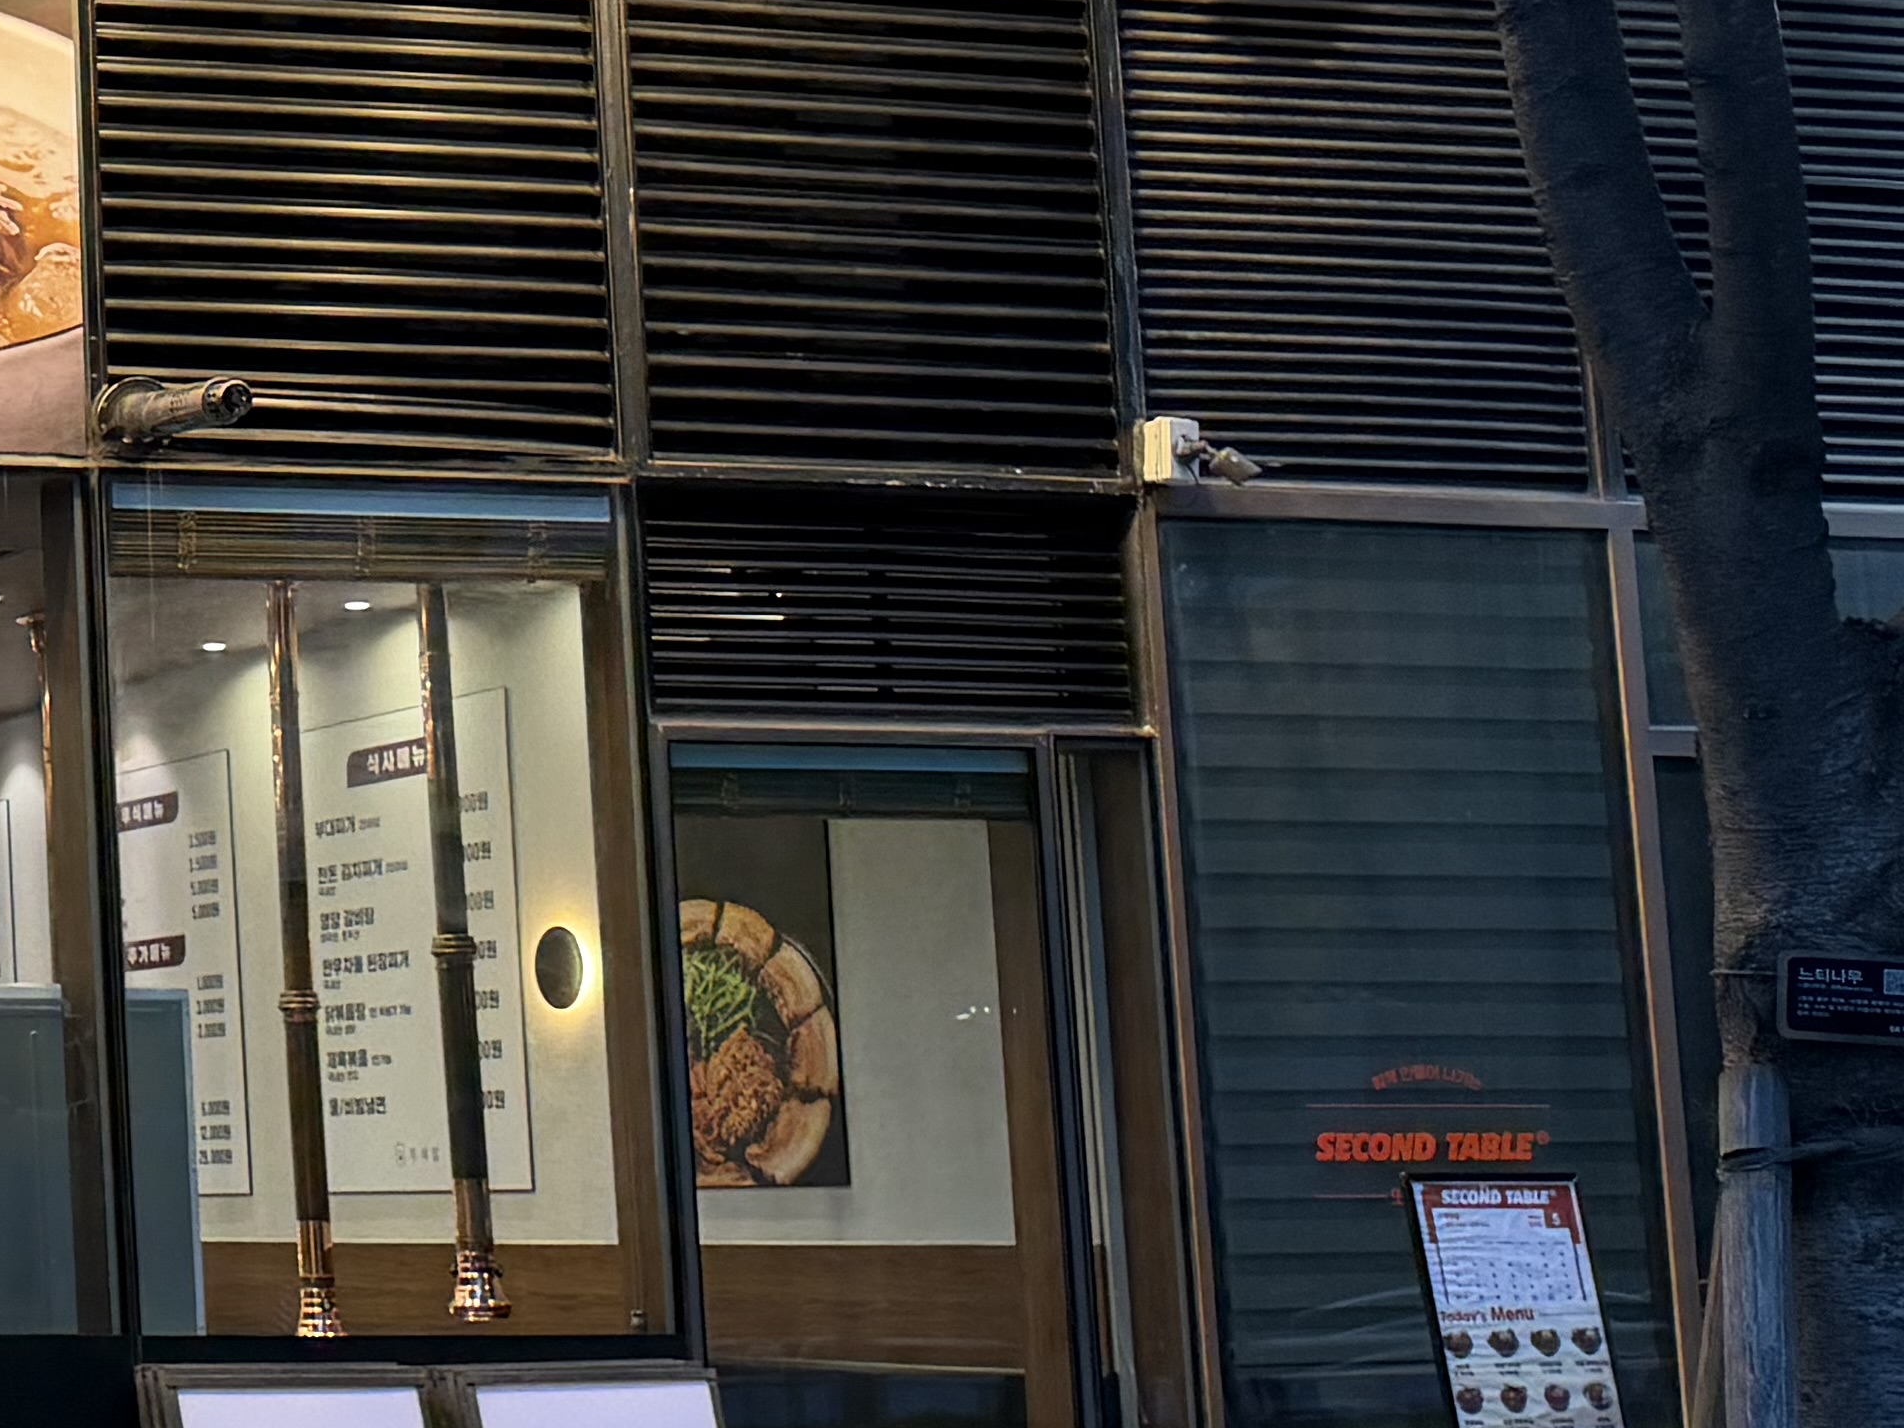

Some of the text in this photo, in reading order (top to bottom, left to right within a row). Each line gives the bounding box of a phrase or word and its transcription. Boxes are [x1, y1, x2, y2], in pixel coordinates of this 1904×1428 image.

[1315, 1131, 1437, 1162] SECOND
[1441, 1188, 1502, 1205] SECOND
[1491, 1306, 1535, 1323] Menu
